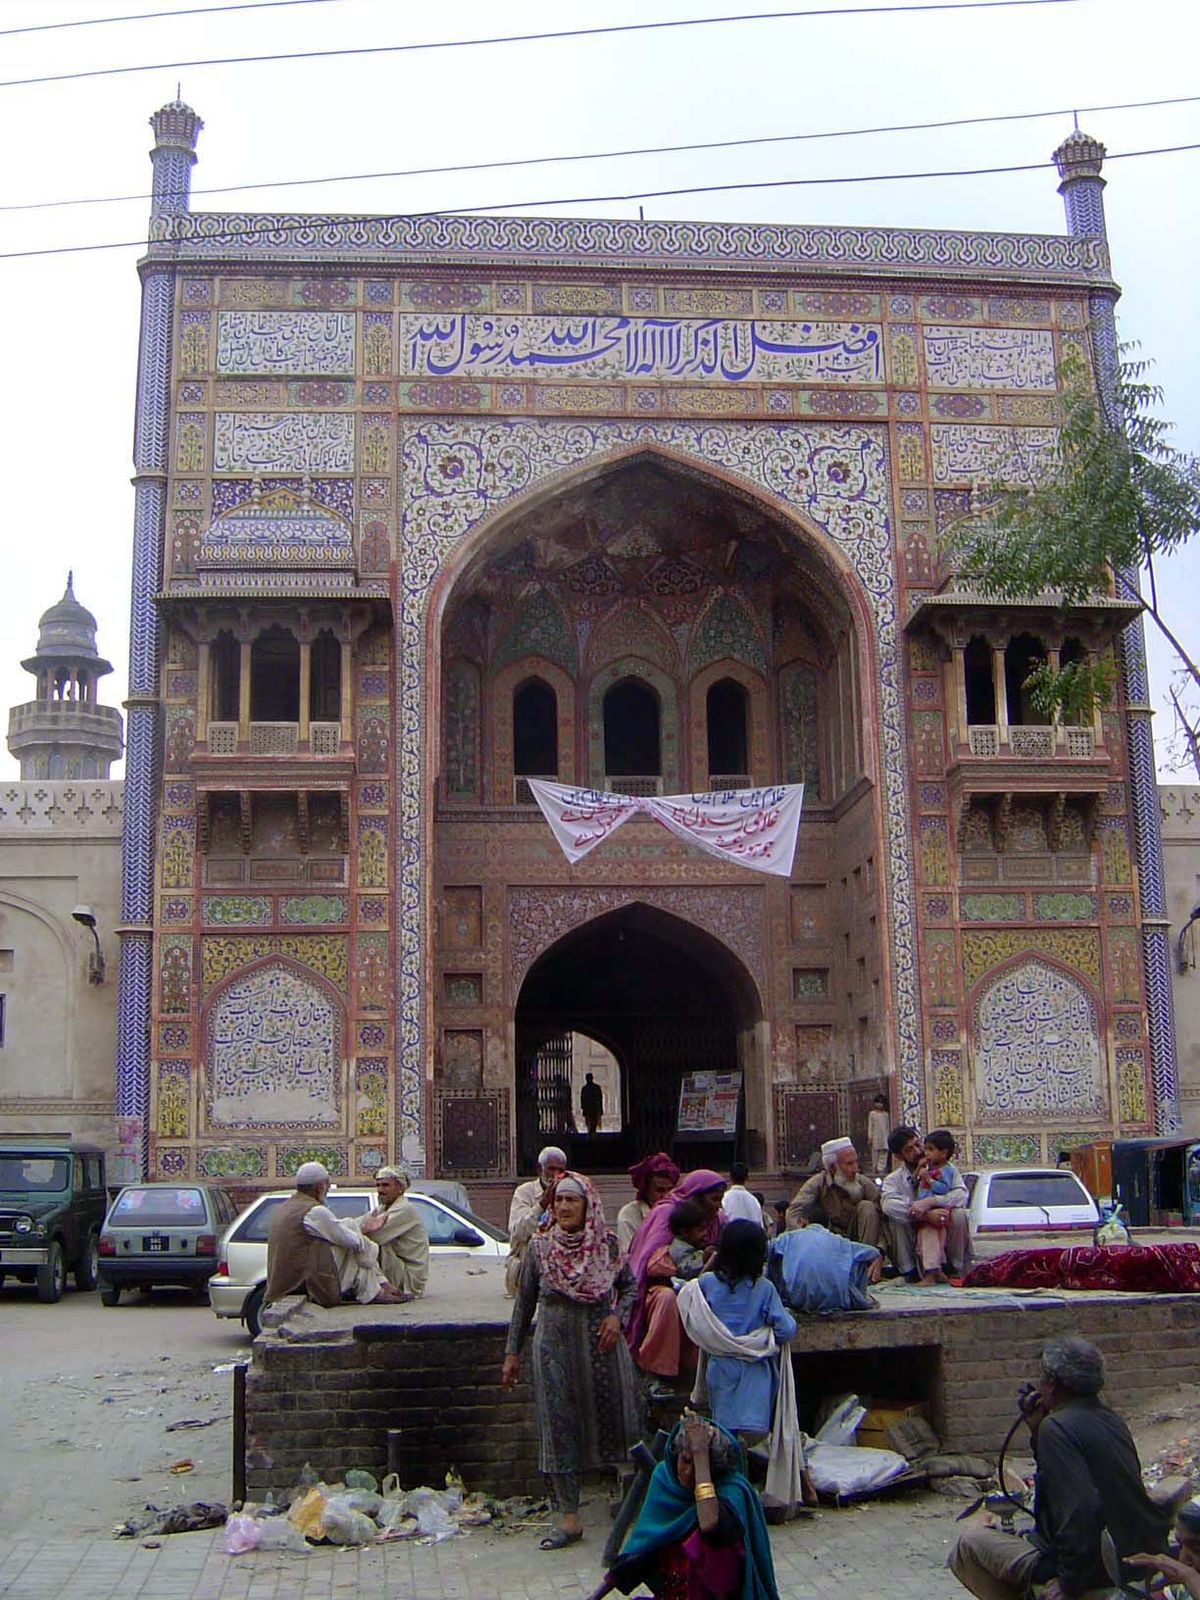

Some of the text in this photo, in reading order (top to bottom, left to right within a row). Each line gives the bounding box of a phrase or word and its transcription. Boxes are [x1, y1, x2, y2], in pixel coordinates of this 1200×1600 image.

[408, 317, 456, 370] الله
[427, 314, 504, 375] رسول
[500, 317, 631, 367] محمد
[541, 317, 597, 349] الله
[672, 319, 739, 376] الذکر
[721, 320, 879, 380] افضل
